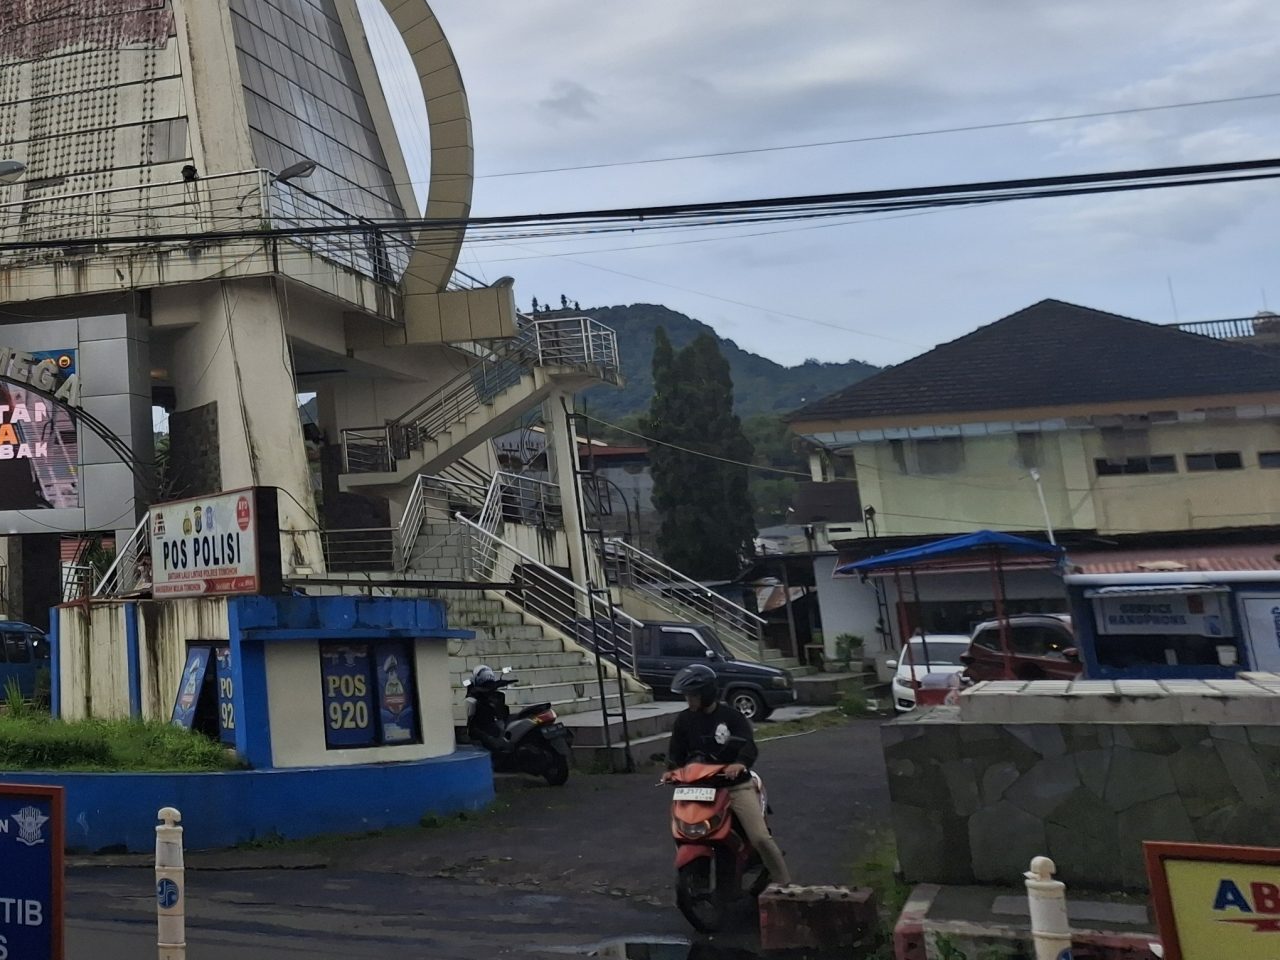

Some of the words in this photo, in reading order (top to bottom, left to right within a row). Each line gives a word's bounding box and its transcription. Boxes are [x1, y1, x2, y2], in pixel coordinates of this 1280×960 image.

[163, 539, 188, 571] POS
[193, 532, 241, 568] POLISI
[327, 674, 367, 698] POS
[329, 701, 369, 730] 920
